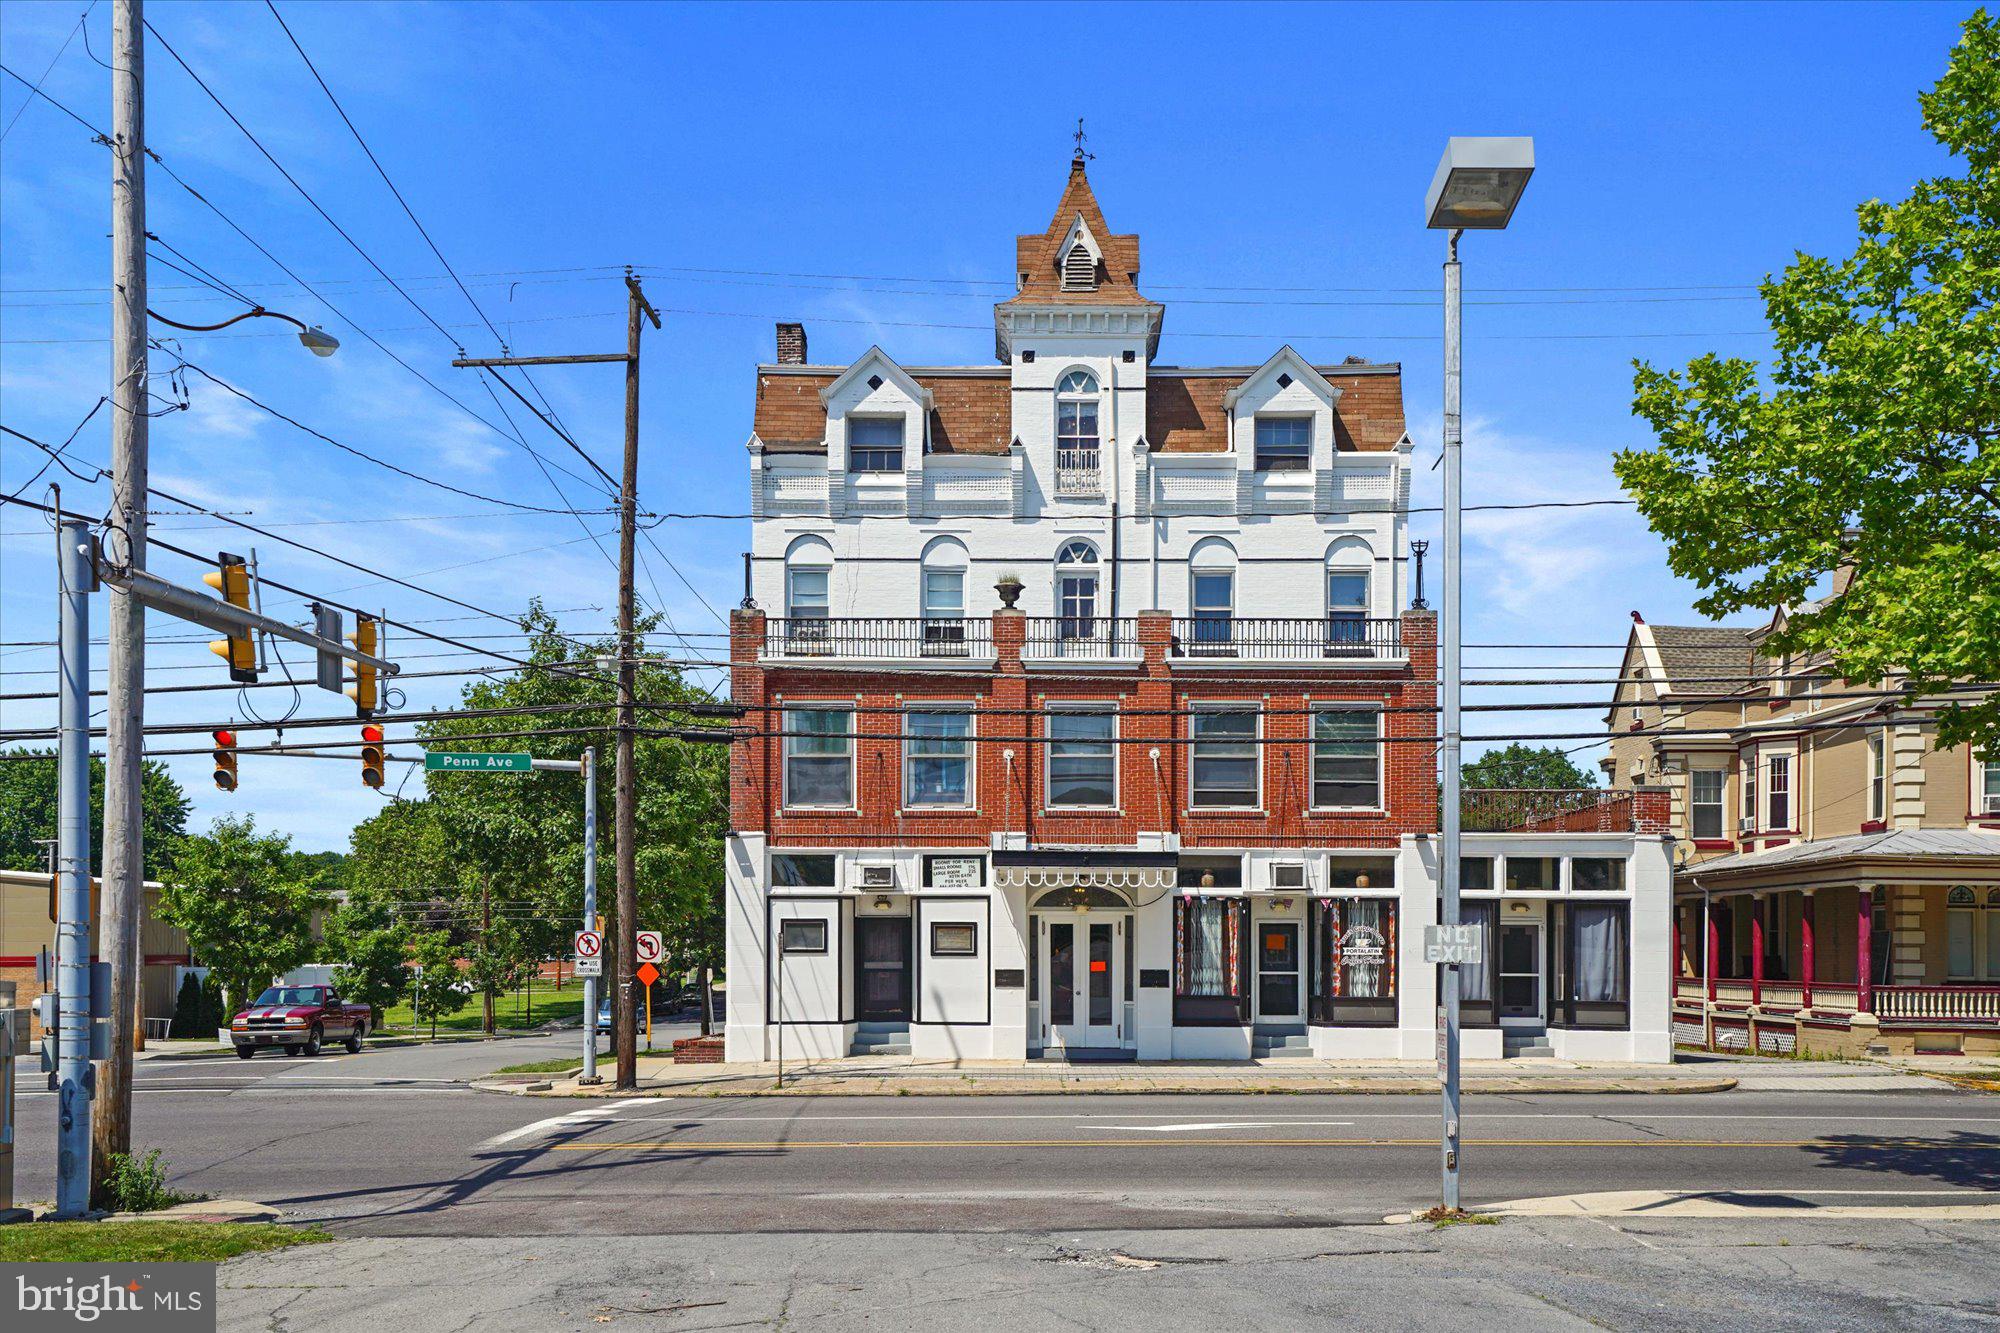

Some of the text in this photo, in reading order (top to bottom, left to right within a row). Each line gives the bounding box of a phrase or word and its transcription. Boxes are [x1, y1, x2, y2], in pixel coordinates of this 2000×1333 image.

[443, 756, 513, 767] Penn Ave
[1436, 926, 1469, 943] NO
[1427, 945, 1477, 962] EXIT
